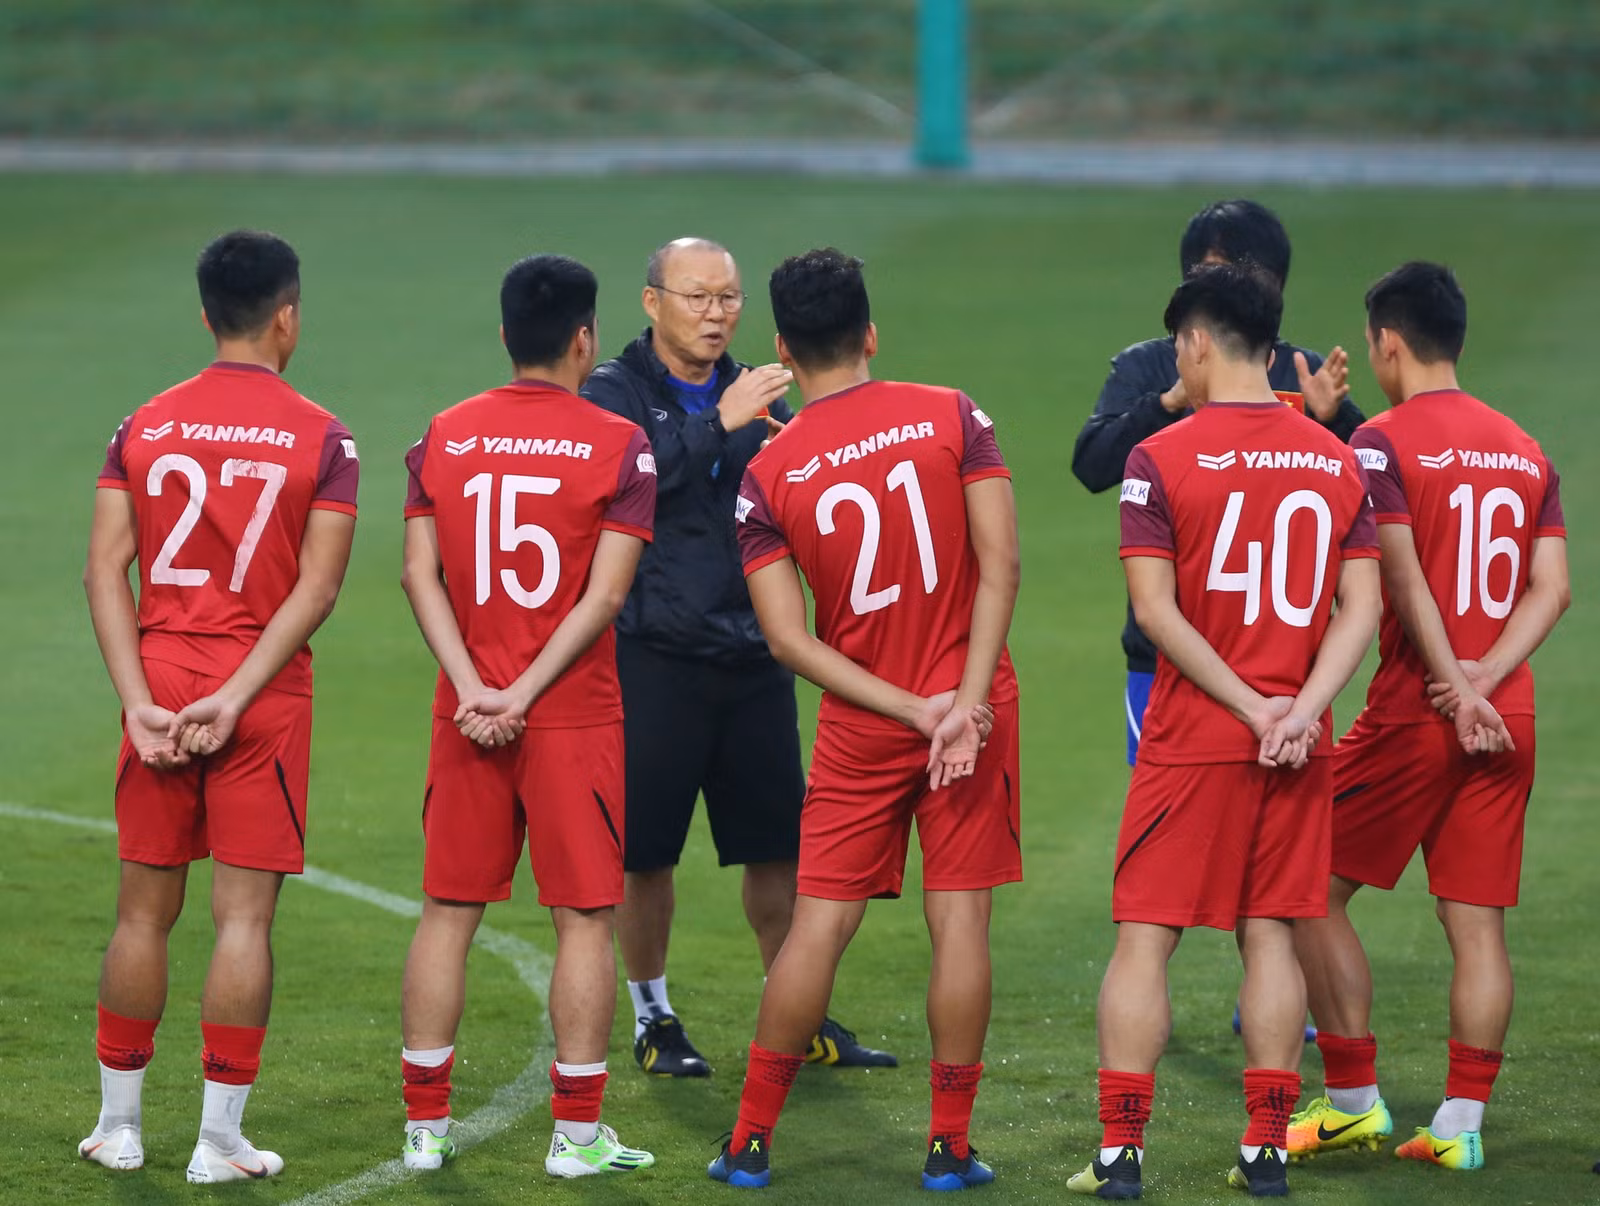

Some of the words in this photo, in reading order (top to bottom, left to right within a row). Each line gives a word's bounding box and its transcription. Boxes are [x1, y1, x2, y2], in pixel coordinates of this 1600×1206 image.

[180, 422, 296, 449] YANMAR
[482, 436, 593, 460] YANMAR
[823, 421, 936, 468] YANMAR
[1241, 451, 1343, 477] YANMAR
[1457, 449, 1541, 480] YANMAR
[146, 453, 288, 593] 27
[463, 472, 561, 609] 15
[815, 459, 939, 616] 21
[1206, 489, 1333, 628] 40
[1449, 483, 1526, 620] 16
